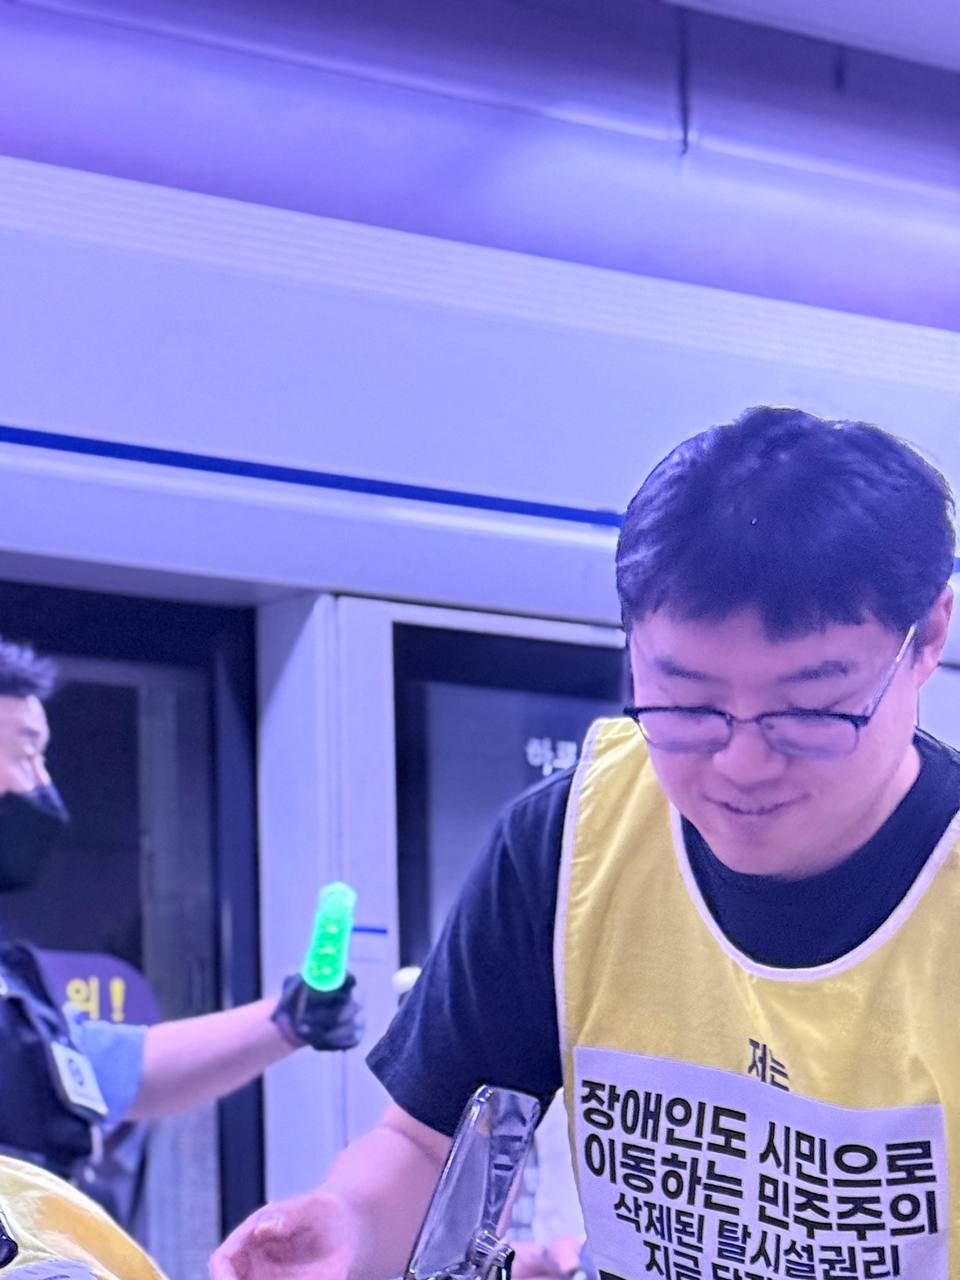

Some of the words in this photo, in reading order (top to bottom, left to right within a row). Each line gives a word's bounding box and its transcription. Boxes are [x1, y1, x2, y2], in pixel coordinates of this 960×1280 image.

[747, 1037, 790, 1093] 저는
[580, 1079, 748, 1160] 장애인도
[759, 1120, 938, 1189] 시민으로
[583, 1132, 745, 1215] 이동하는
[757, 1173, 939, 1242] 민주주의
[612, 1191, 705, 1254] 삭제된
